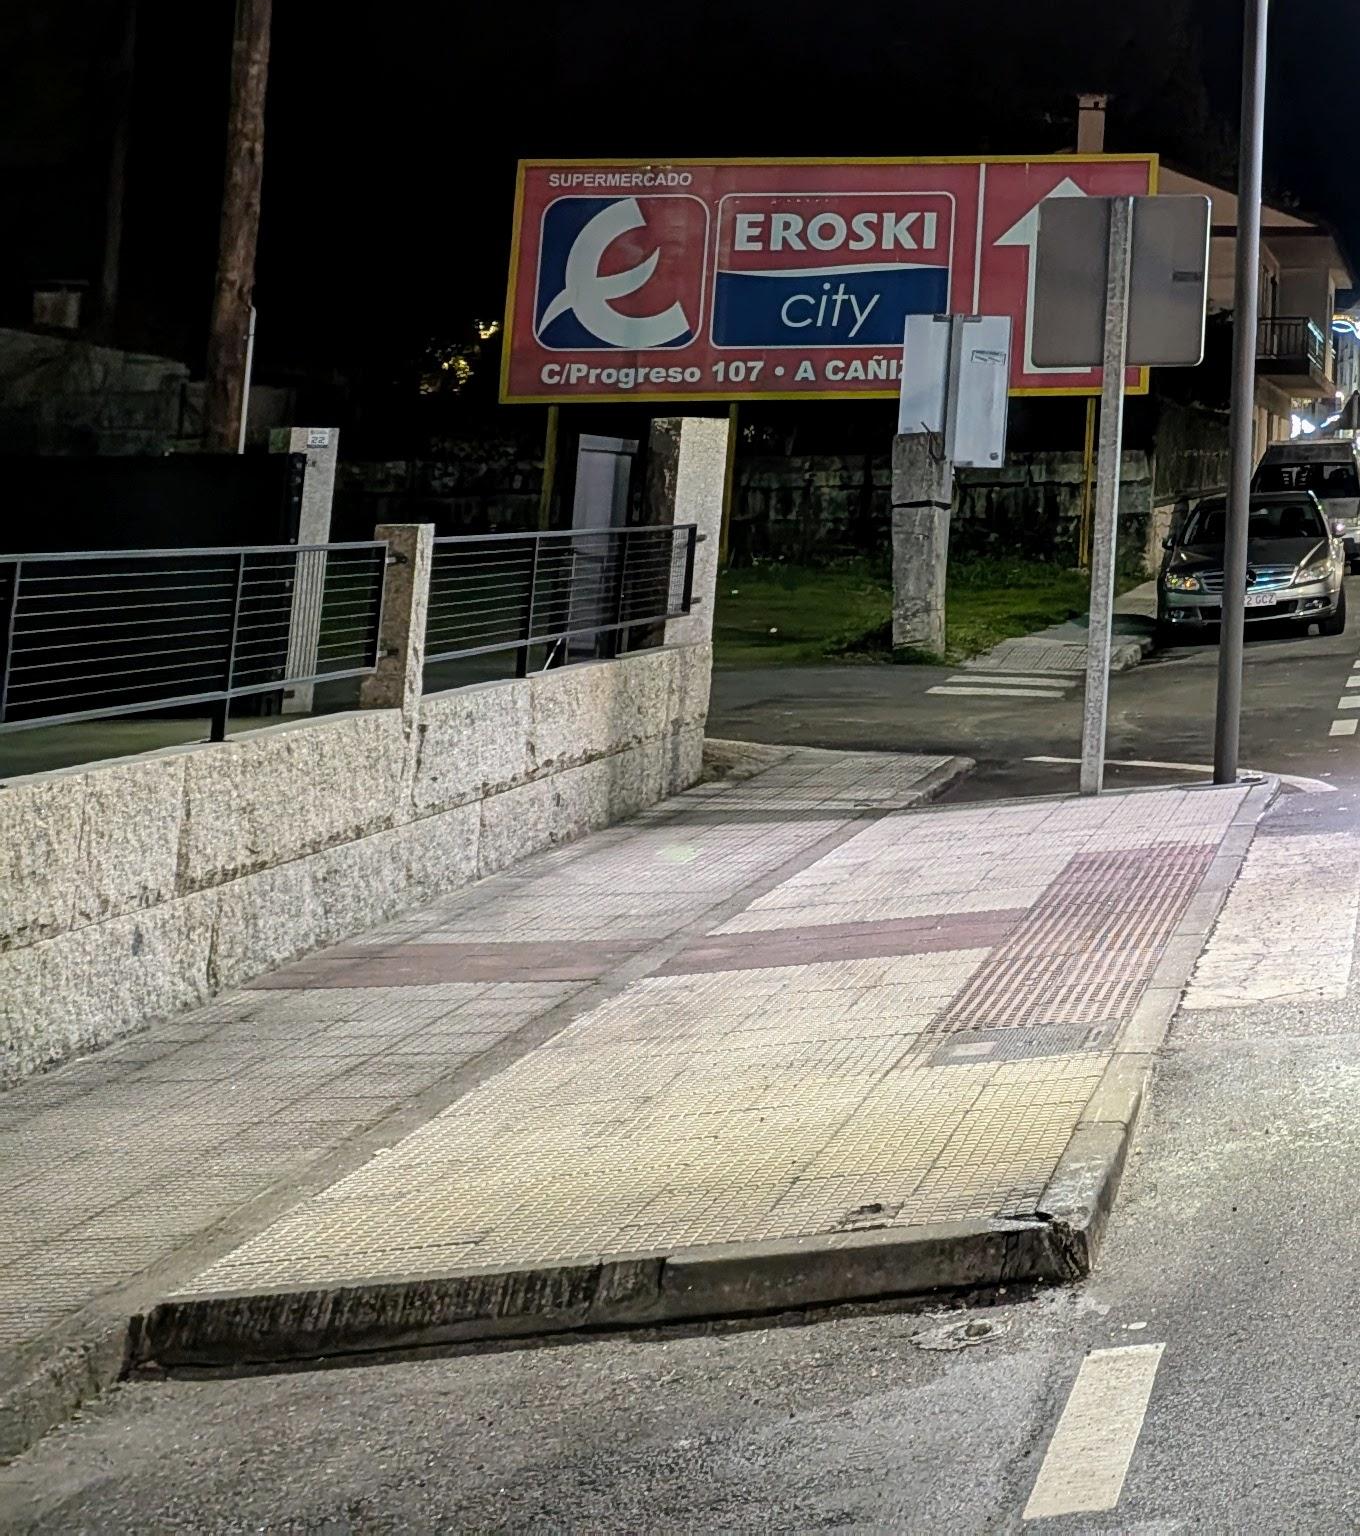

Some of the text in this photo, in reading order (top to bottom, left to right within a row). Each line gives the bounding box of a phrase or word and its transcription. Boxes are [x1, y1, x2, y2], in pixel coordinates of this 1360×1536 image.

[549, 172, 692, 187] SUPERMERCADO
[734, 212, 938, 251] EROSKI
[781, 282, 880, 338] city
[541, 355, 904, 389] C/Progreso 107 A CAÑI
